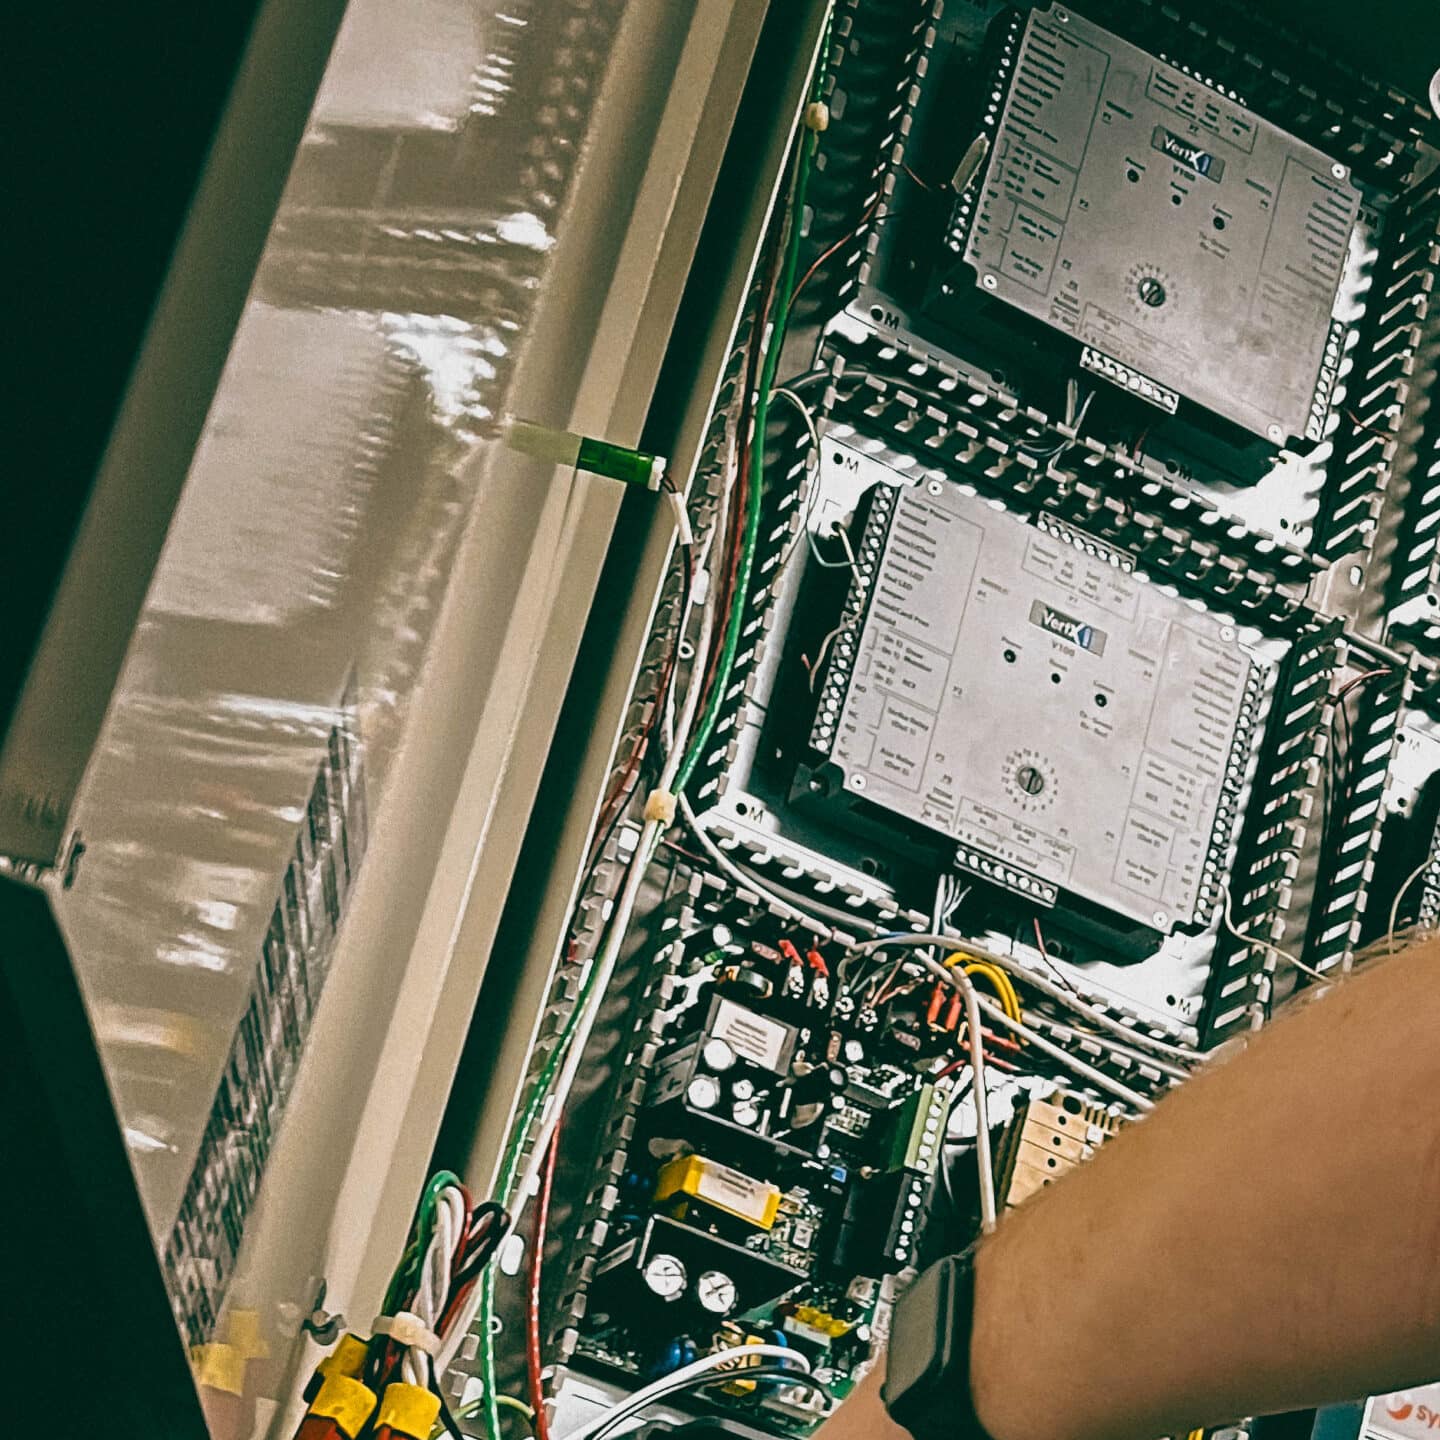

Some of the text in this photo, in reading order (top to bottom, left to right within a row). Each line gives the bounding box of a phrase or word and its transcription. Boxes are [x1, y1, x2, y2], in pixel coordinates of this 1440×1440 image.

[1161, 130, 1205, 173] VertX
[884, 312, 900, 330] M
[845, 457, 859, 474] M
[1179, 465, 1192, 482] M
[1039, 604, 1085, 646] VertX
[749, 807, 763, 824] M
